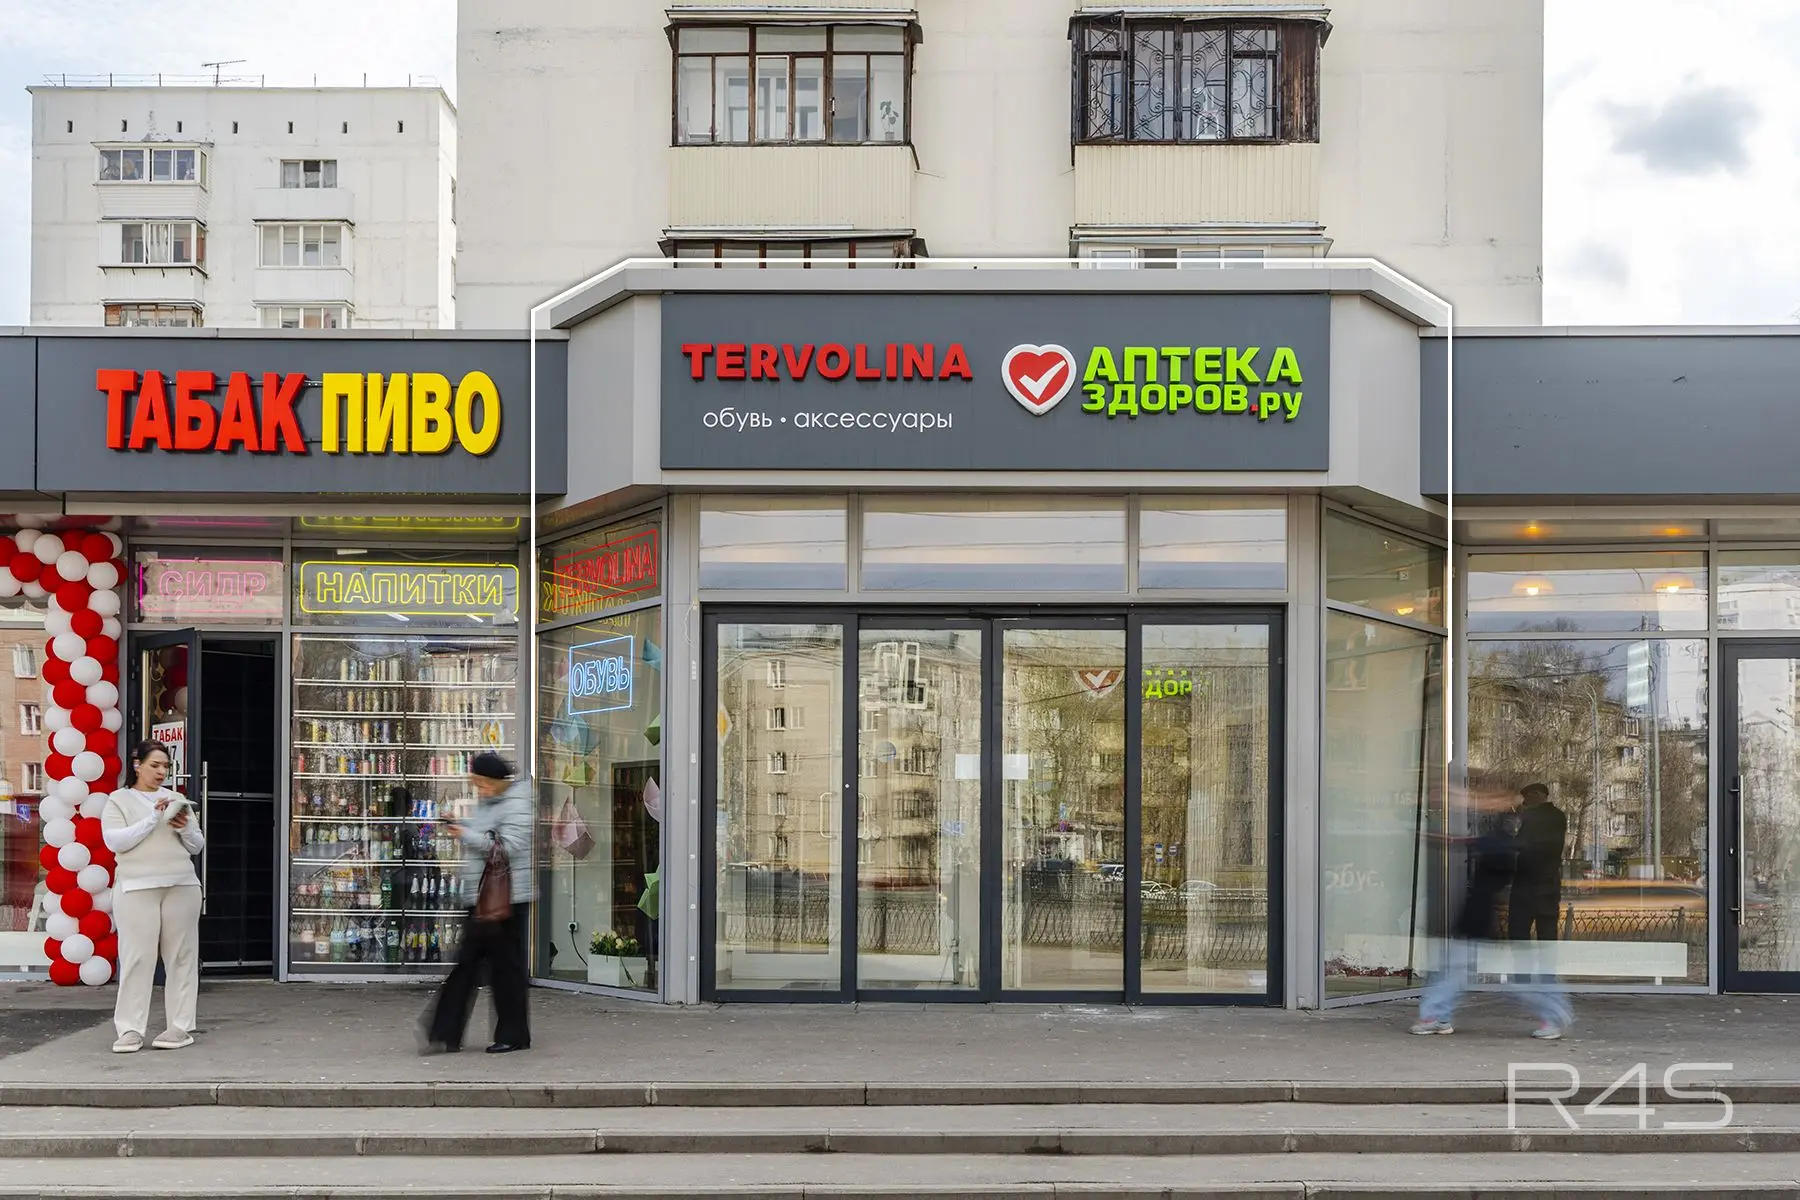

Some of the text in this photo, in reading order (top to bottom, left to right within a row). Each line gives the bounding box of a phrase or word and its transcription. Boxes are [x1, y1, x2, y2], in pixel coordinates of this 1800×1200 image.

[682, 343, 973, 381] TERVOLINA
[1083, 346, 1303, 385] АПТЕКА
[96, 369, 501, 457] ТАБАК ПИВО
[703, 407, 952, 433] обувь аксессуары
[159, 570, 266, 608] СИДР
[316, 571, 503, 605] НАПИТКИ
[572, 655, 630, 697] ОБУВЬ
[1142, 679, 1193, 699] ДОР
[154, 727, 183, 742] ТАБАК
